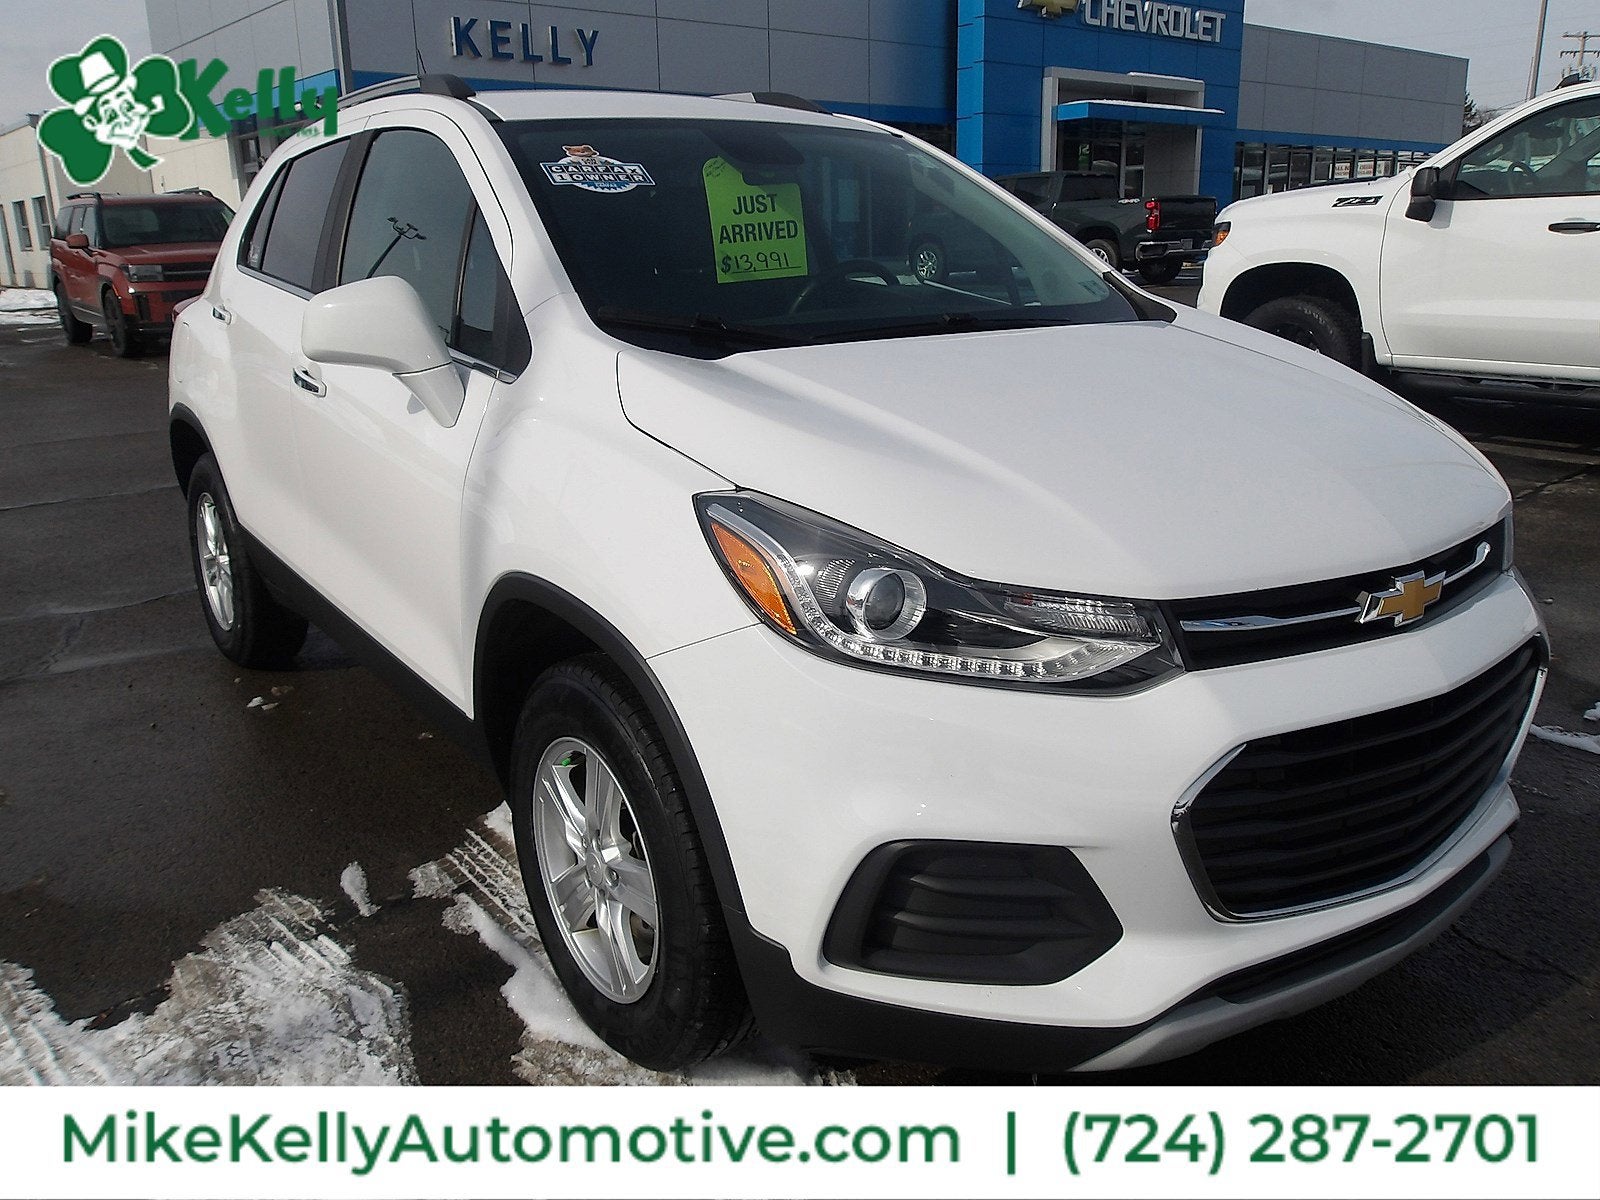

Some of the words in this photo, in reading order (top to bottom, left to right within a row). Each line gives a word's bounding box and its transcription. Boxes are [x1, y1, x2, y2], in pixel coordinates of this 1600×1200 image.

[1085, 0, 1226, 43] CHEVROLET
[451, 16, 599, 66] KELLY
[551, 165, 638, 174] CARFAX
[733, 194, 777, 215] JUST
[720, 220, 798, 244] ARRIVED
[721, 252, 789, 274] $13,991
